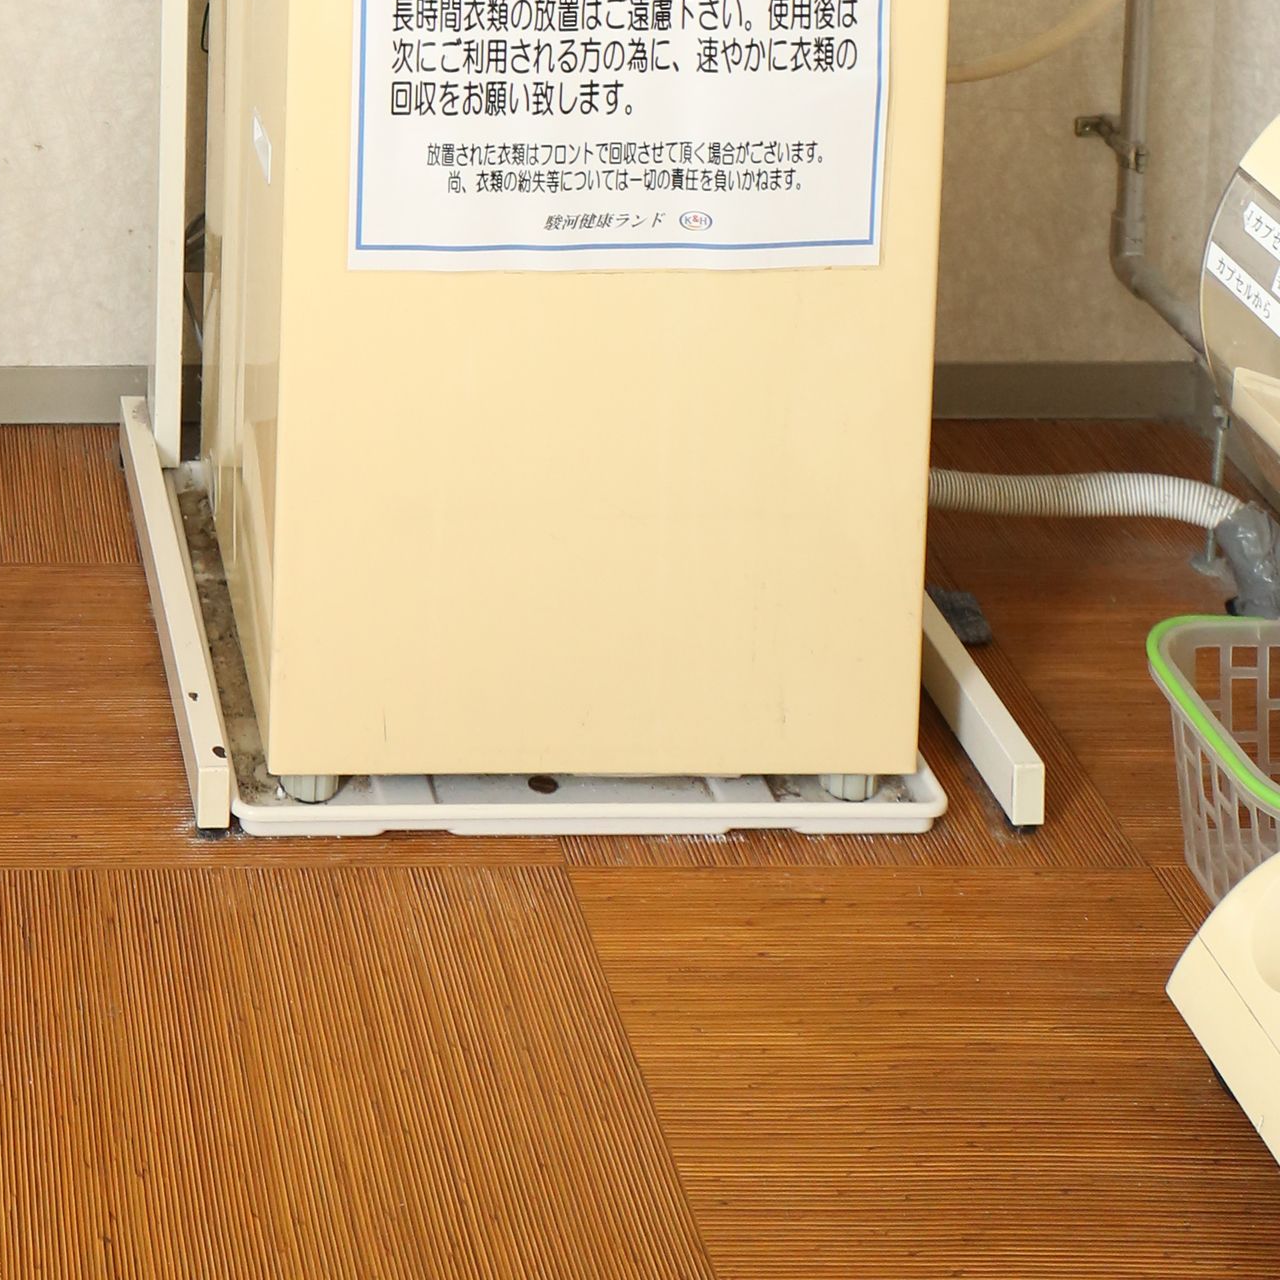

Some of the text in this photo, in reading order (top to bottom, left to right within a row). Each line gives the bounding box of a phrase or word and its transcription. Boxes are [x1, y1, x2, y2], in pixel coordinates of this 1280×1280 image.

[391, 35, 858, 75] 次にご利用される方の為に、速やかに衣類の
[390, 78, 634, 118] 回収をお願い致します。
[425, 140, 825, 167] 放置された衣類はフロントで回収させて頂く場合がございます。
[446, 167, 804, 195] 尚、衣類の紛失等については一切の責任を負いかねます。
[543, 211, 666, 233] 駿河健康ランド
